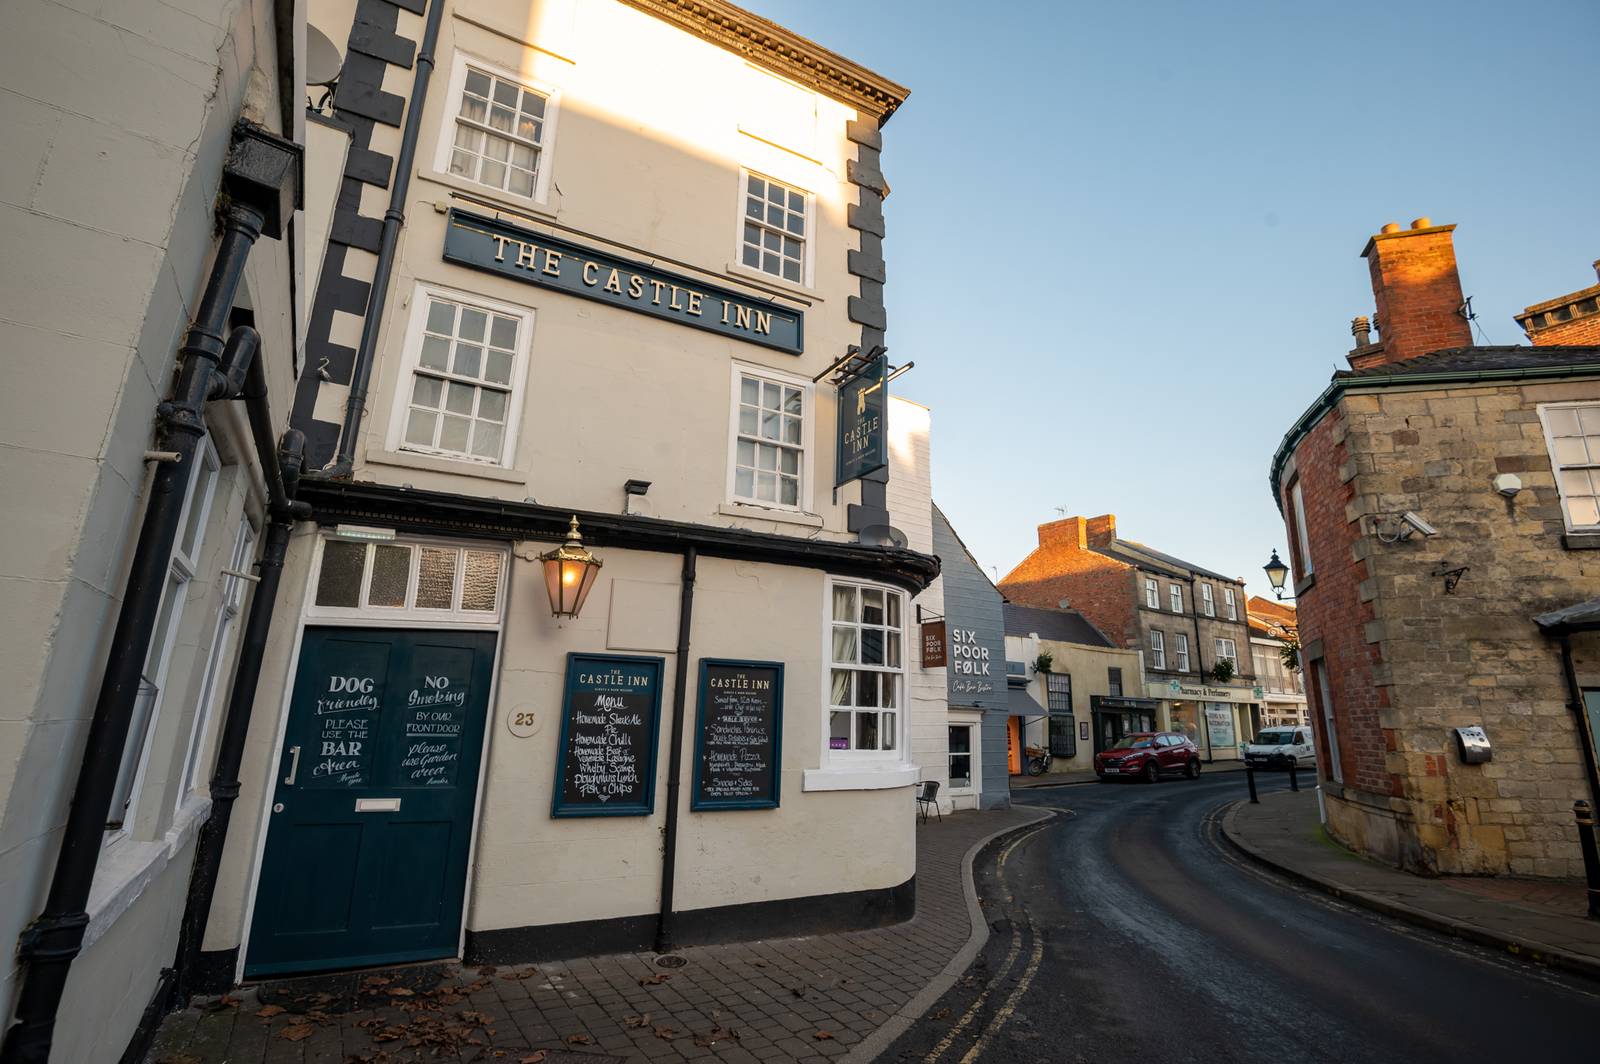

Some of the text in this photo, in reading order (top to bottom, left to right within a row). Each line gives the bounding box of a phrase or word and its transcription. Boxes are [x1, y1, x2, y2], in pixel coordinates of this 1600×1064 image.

[492, 233, 774, 336] THE CASTLE INN
[844, 416, 878, 445] CASTLE
[852, 435, 869, 454] INN
[953, 628, 976, 644] SIX
[953, 644, 990, 661] POOR
[954, 660, 990, 676] FØLK
[328, 675, 375, 693] DOG
[424, 675, 449, 689] NO
[580, 673, 648, 687] CASTLE INN
[710, 678, 770, 690] CASTLE INN
[408, 689, 465, 707] Smoking
[594, 694, 625, 712] Menu
[325, 719, 368, 729] PLEASE
[416, 711, 452, 721] BY OUR
[514, 712, 535, 726] 23
[321, 730, 368, 739] USE THE
[406, 723, 460, 733] FRONT DOOR
[320, 740, 362, 756] BAR
